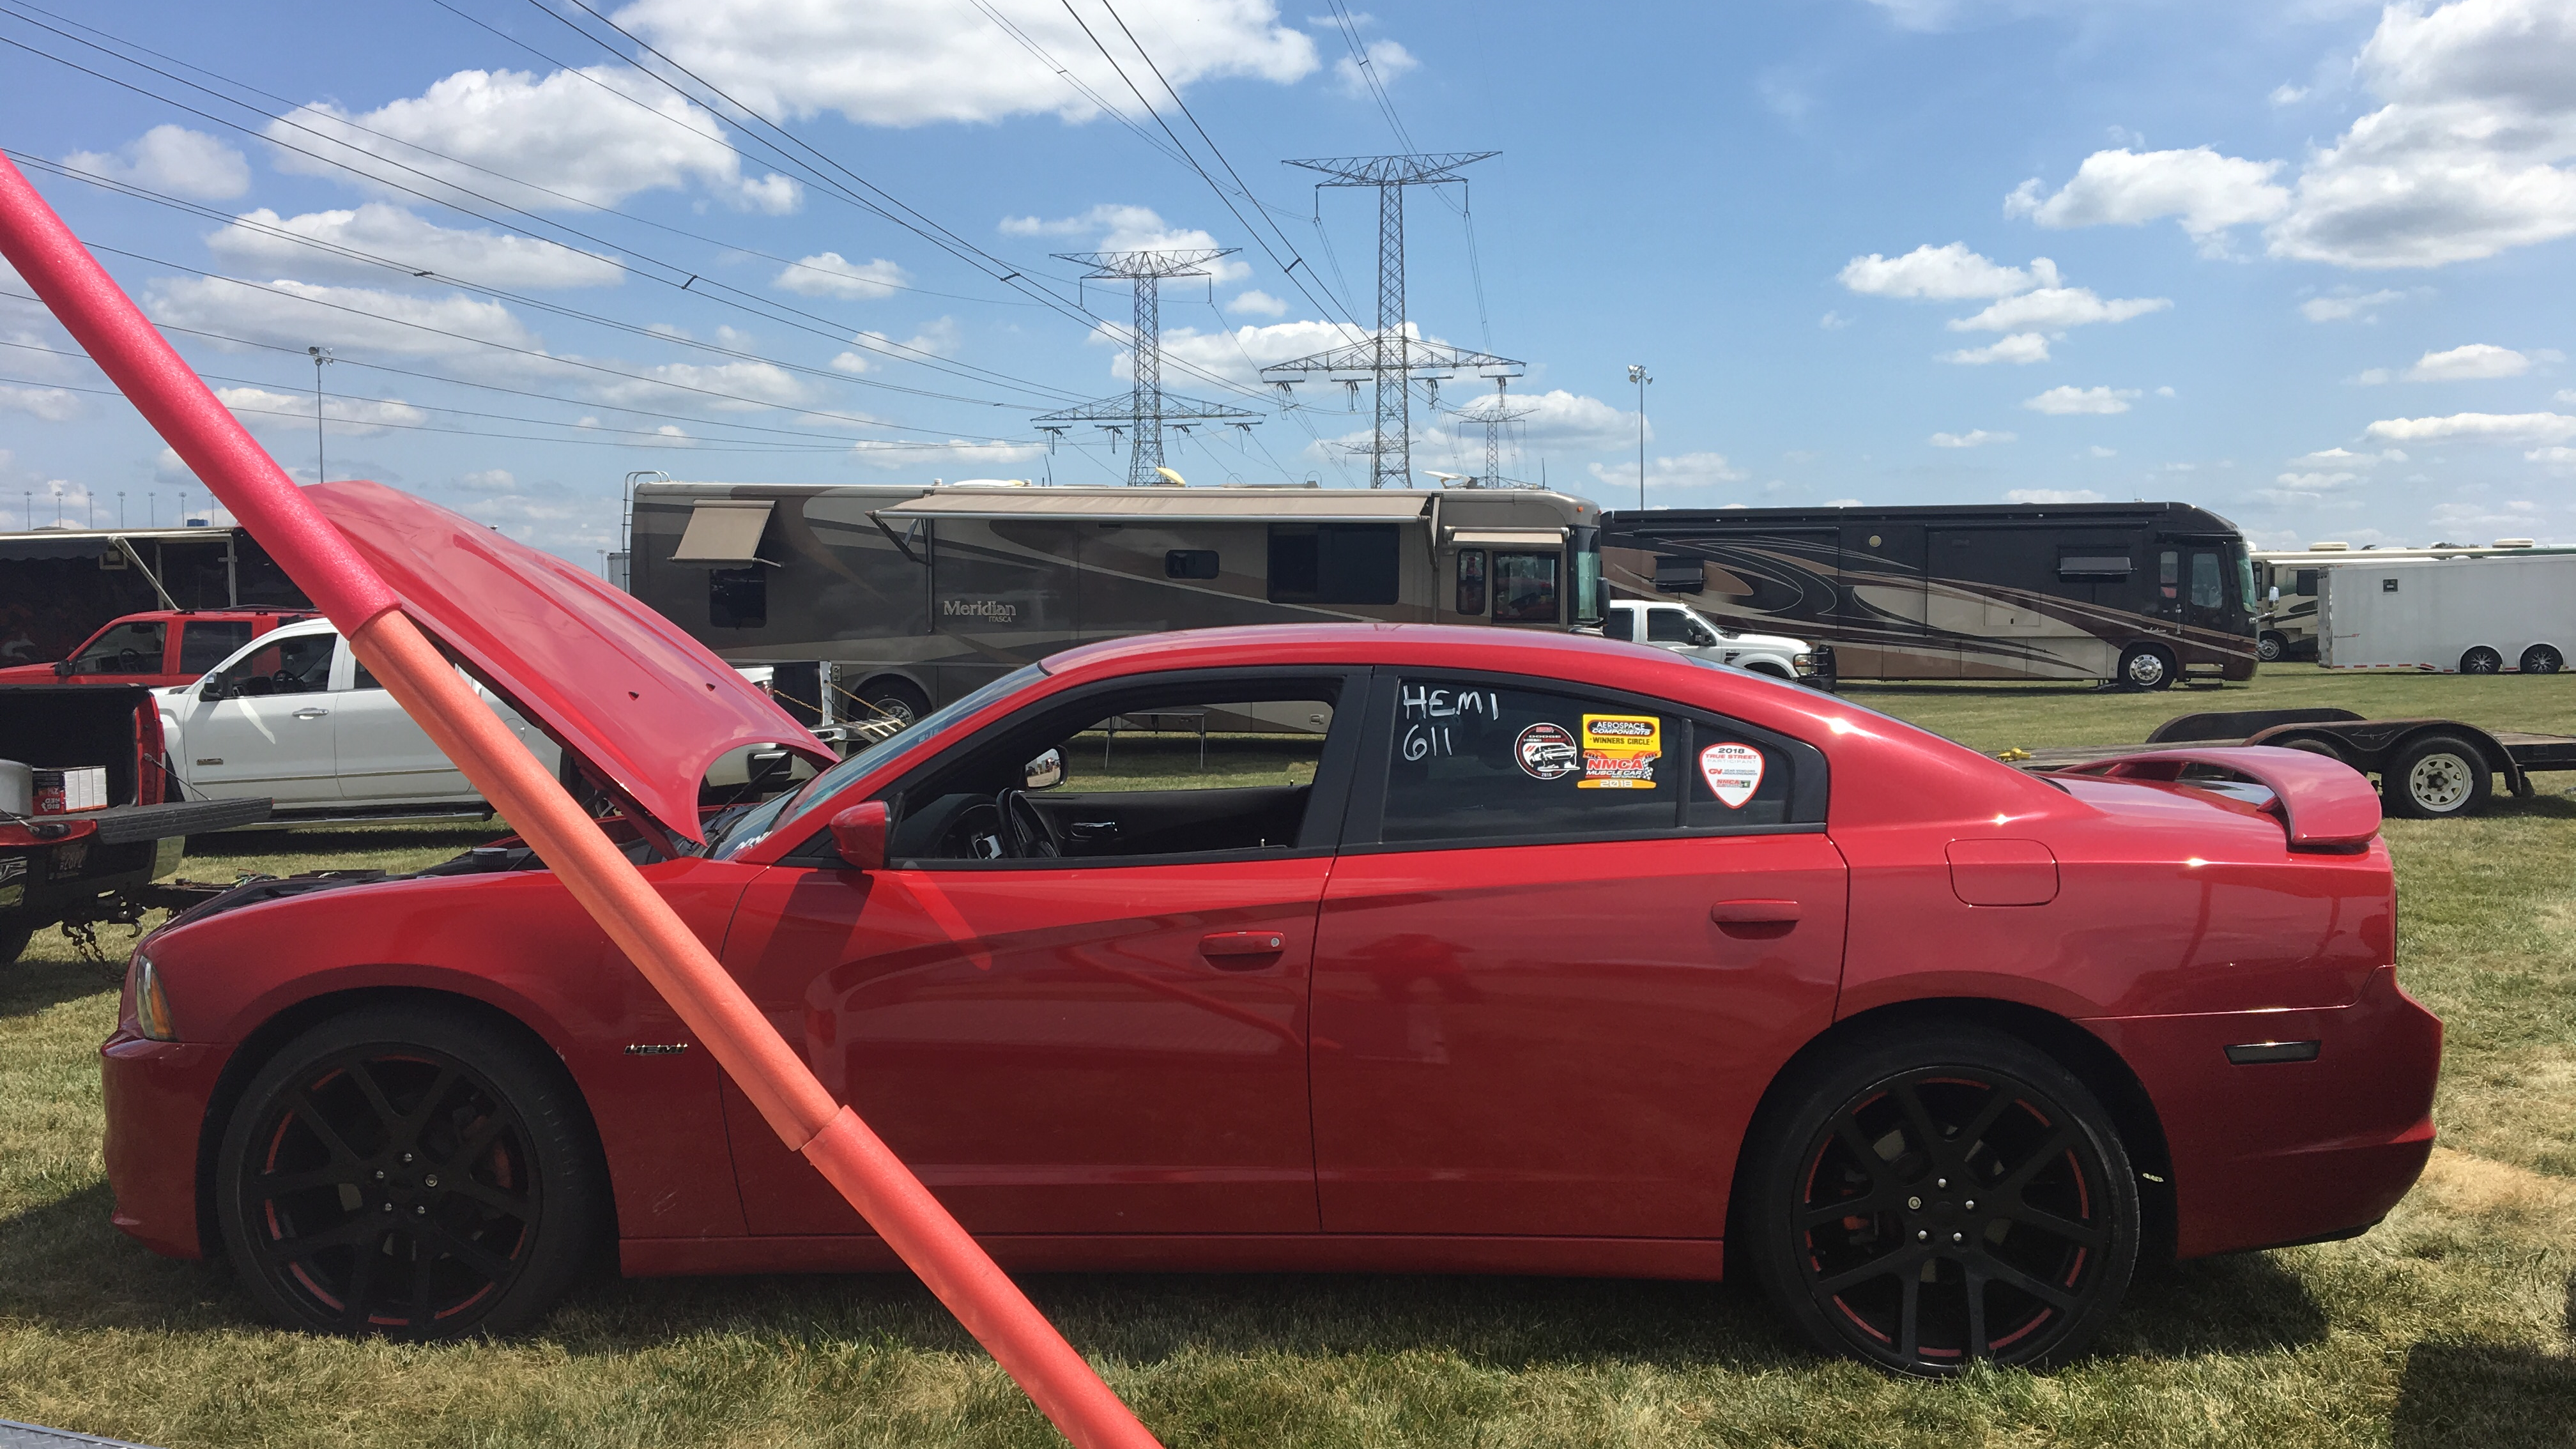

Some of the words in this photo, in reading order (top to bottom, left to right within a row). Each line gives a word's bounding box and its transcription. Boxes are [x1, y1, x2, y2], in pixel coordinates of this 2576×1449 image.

[944, 601, 1016, 615] Meridian
[1403, 685, 1499, 721] HEMI
[1403, 724, 1452, 761] 611
[1586, 759, 1644, 770] NMCA
[624, 1044, 687, 1055] HEMI
